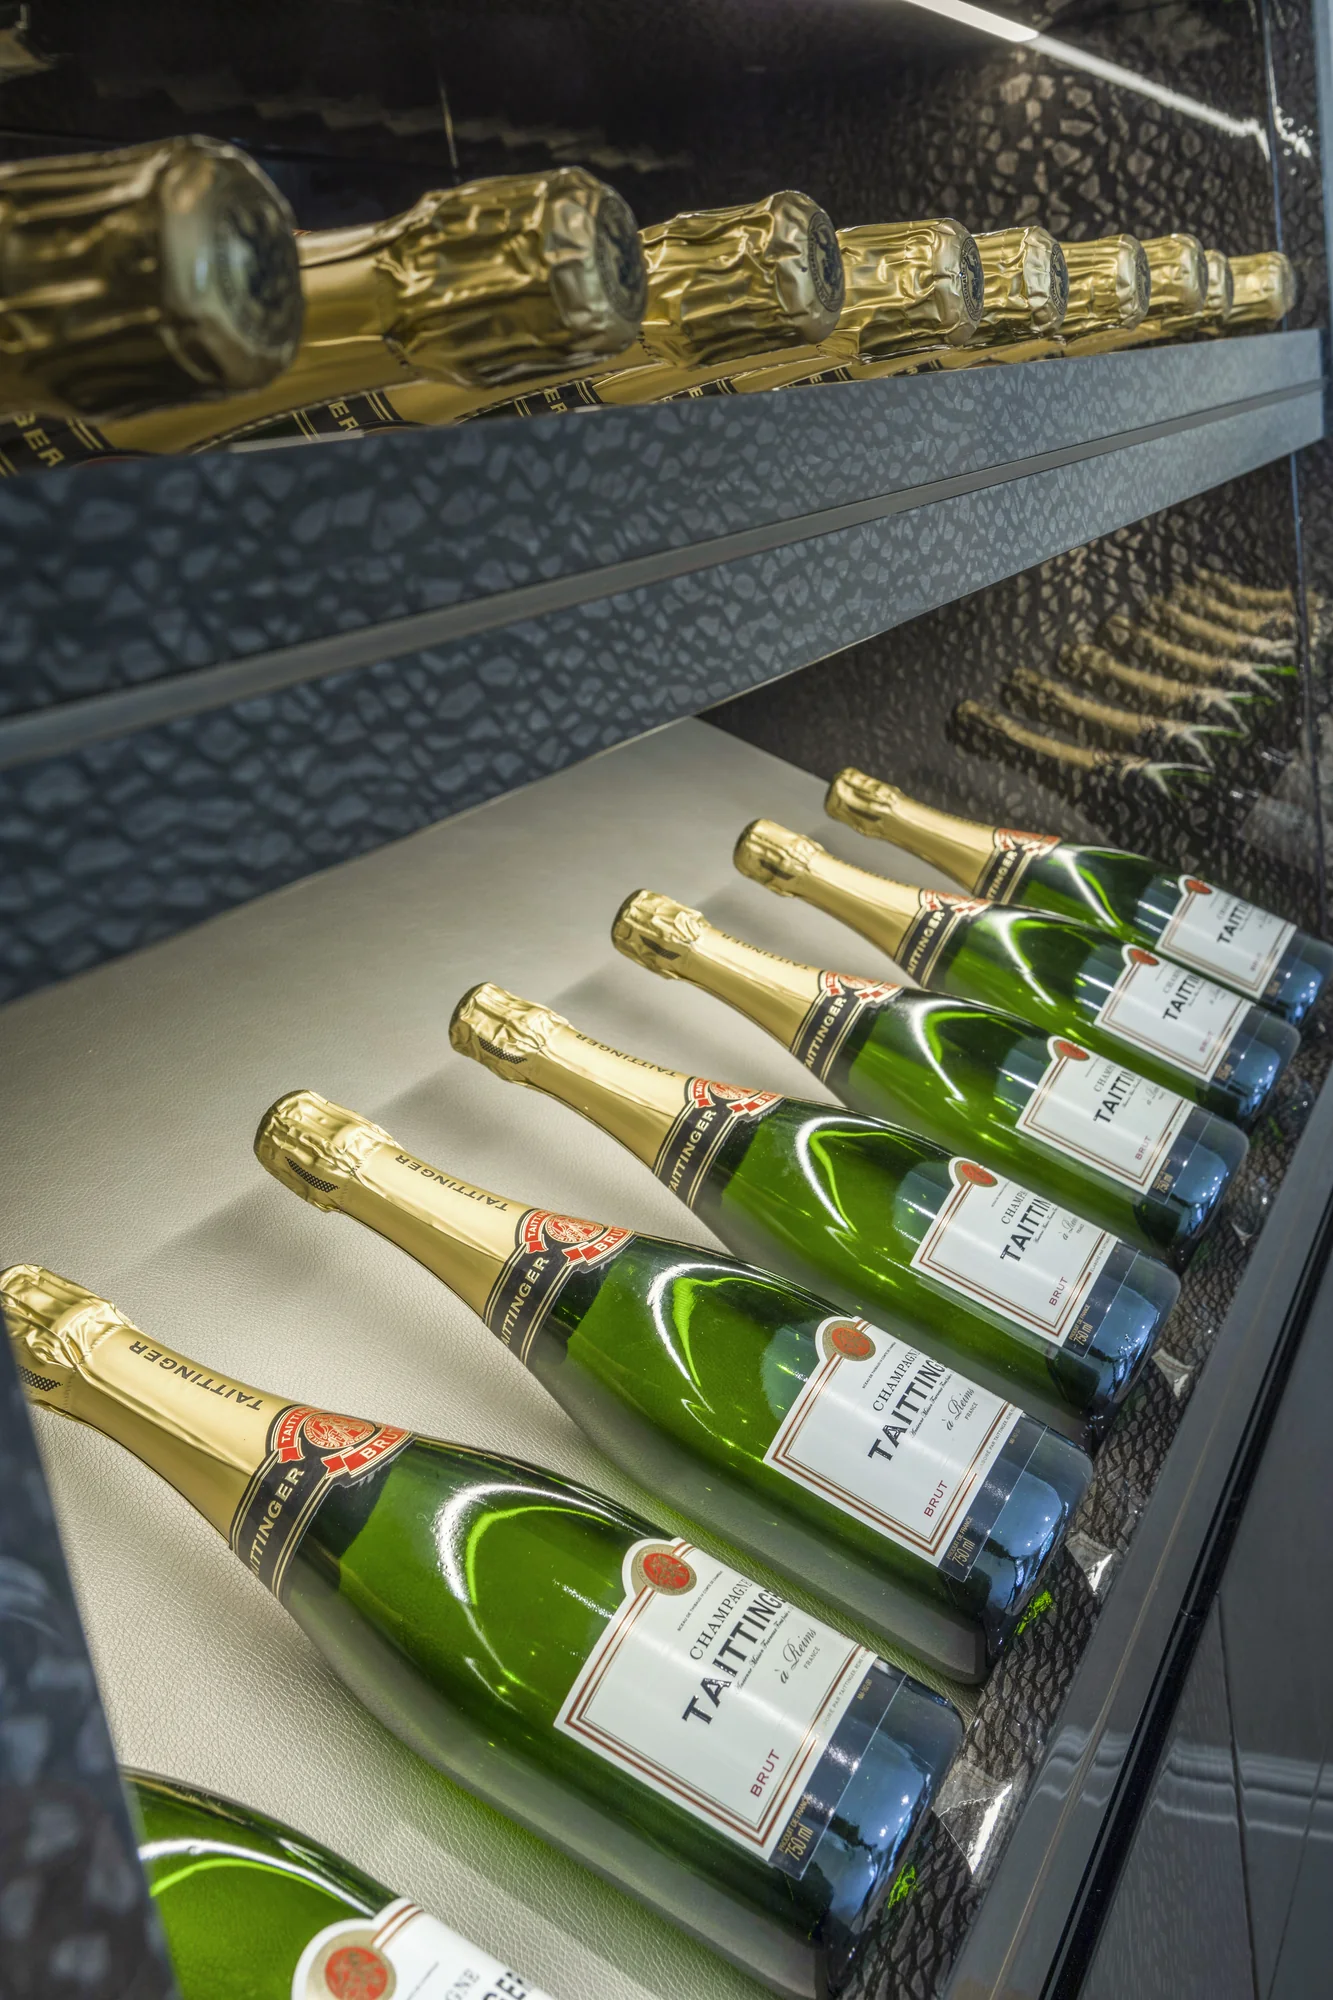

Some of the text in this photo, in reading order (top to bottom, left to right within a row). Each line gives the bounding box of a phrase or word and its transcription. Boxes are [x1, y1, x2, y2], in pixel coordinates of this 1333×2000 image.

[1135, 1136, 1152, 1161] BRUT
[395, 1154, 509, 1212] TAITTINGER
[1049, 1277, 1068, 1306] BRUT
[1073, 1330, 1089, 1346] 750
[129, 1340, 264, 1411] TAITTINGER
[947, 1387, 975, 1420] Reims
[964, 1401, 978, 1421] FRANCE
[942, 1418, 954, 1431] à
[923, 1480, 948, 1518] BRUT
[952, 1538, 976, 1567] 750 ml
[774, 1667, 790, 1684] à
[782, 1627, 817, 1671] Reims
[803, 1646, 821, 1670] FRANCE
[750, 1748, 780, 1798] BRUT
[778, 1825, 795, 1853] PRODUIT
[785, 1822, 814, 1861] 750 ml
